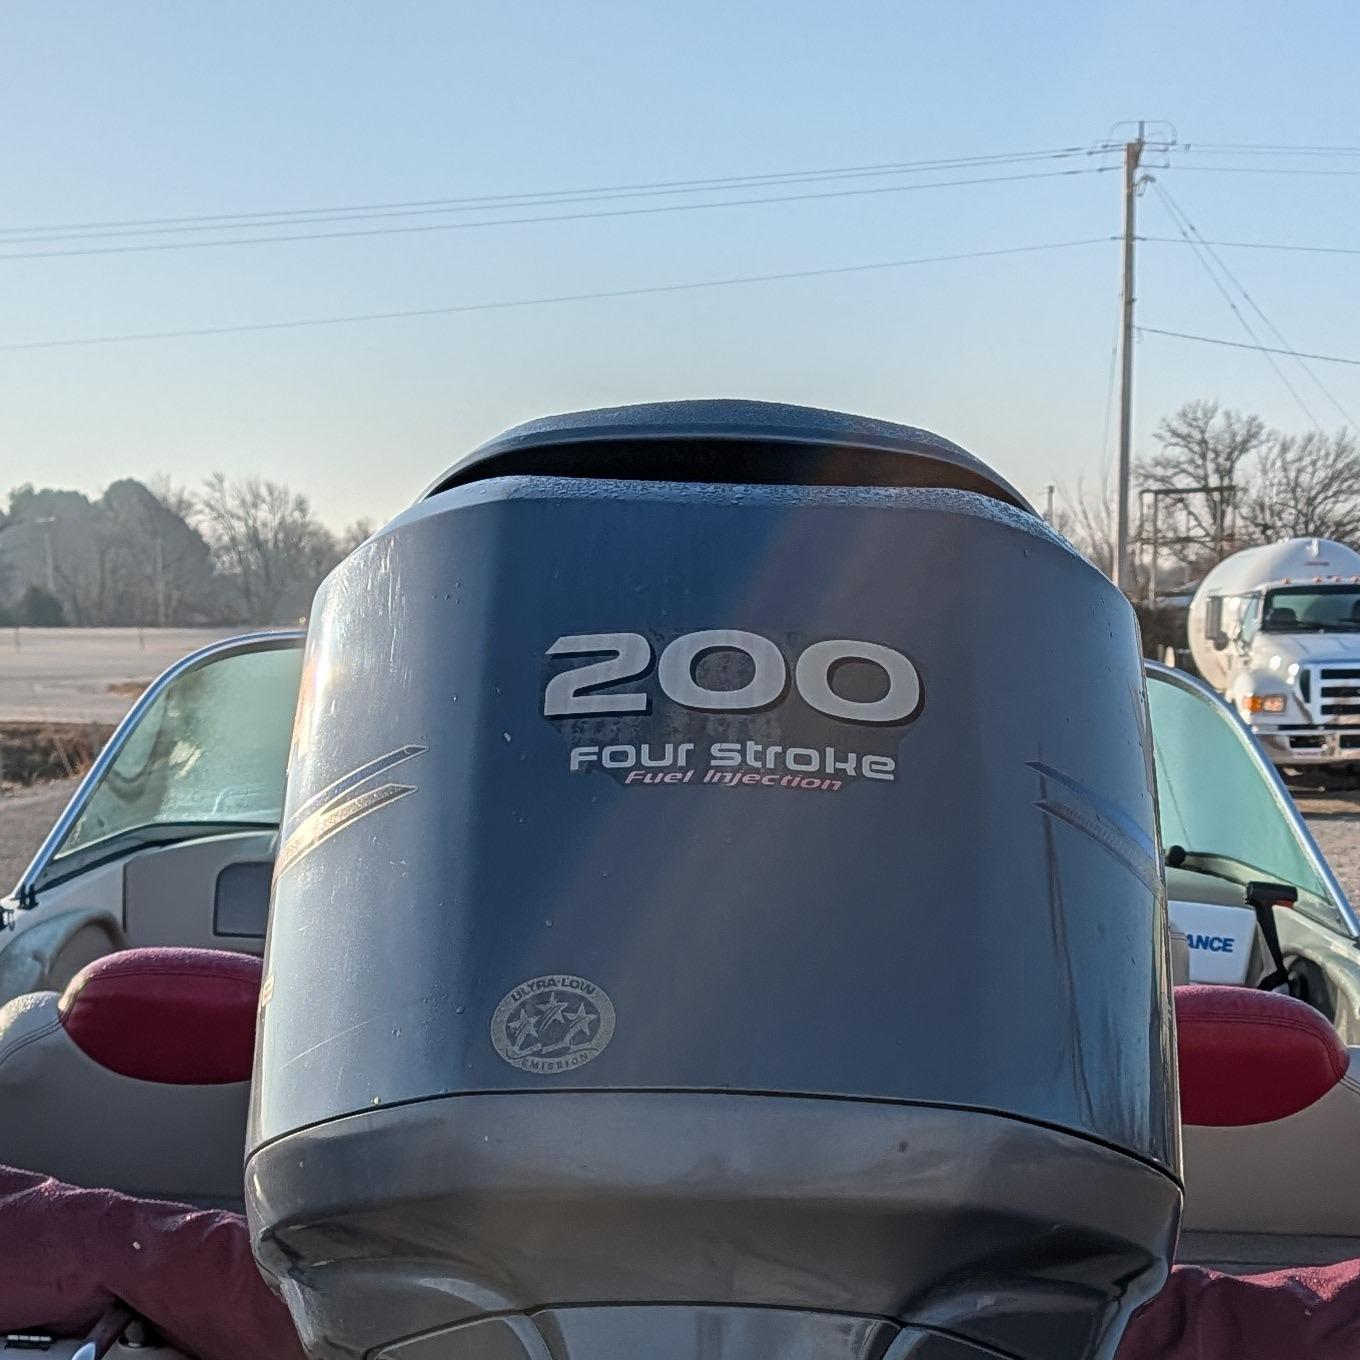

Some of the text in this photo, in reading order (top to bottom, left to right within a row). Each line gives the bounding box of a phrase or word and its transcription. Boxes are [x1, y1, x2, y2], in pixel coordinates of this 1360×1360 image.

[543, 629, 922, 723] 200
[569, 740, 896, 781] Four Stroke
[624, 769, 843, 791] Fuel Injection
[520, 1052, 589, 1072] EMISSION
